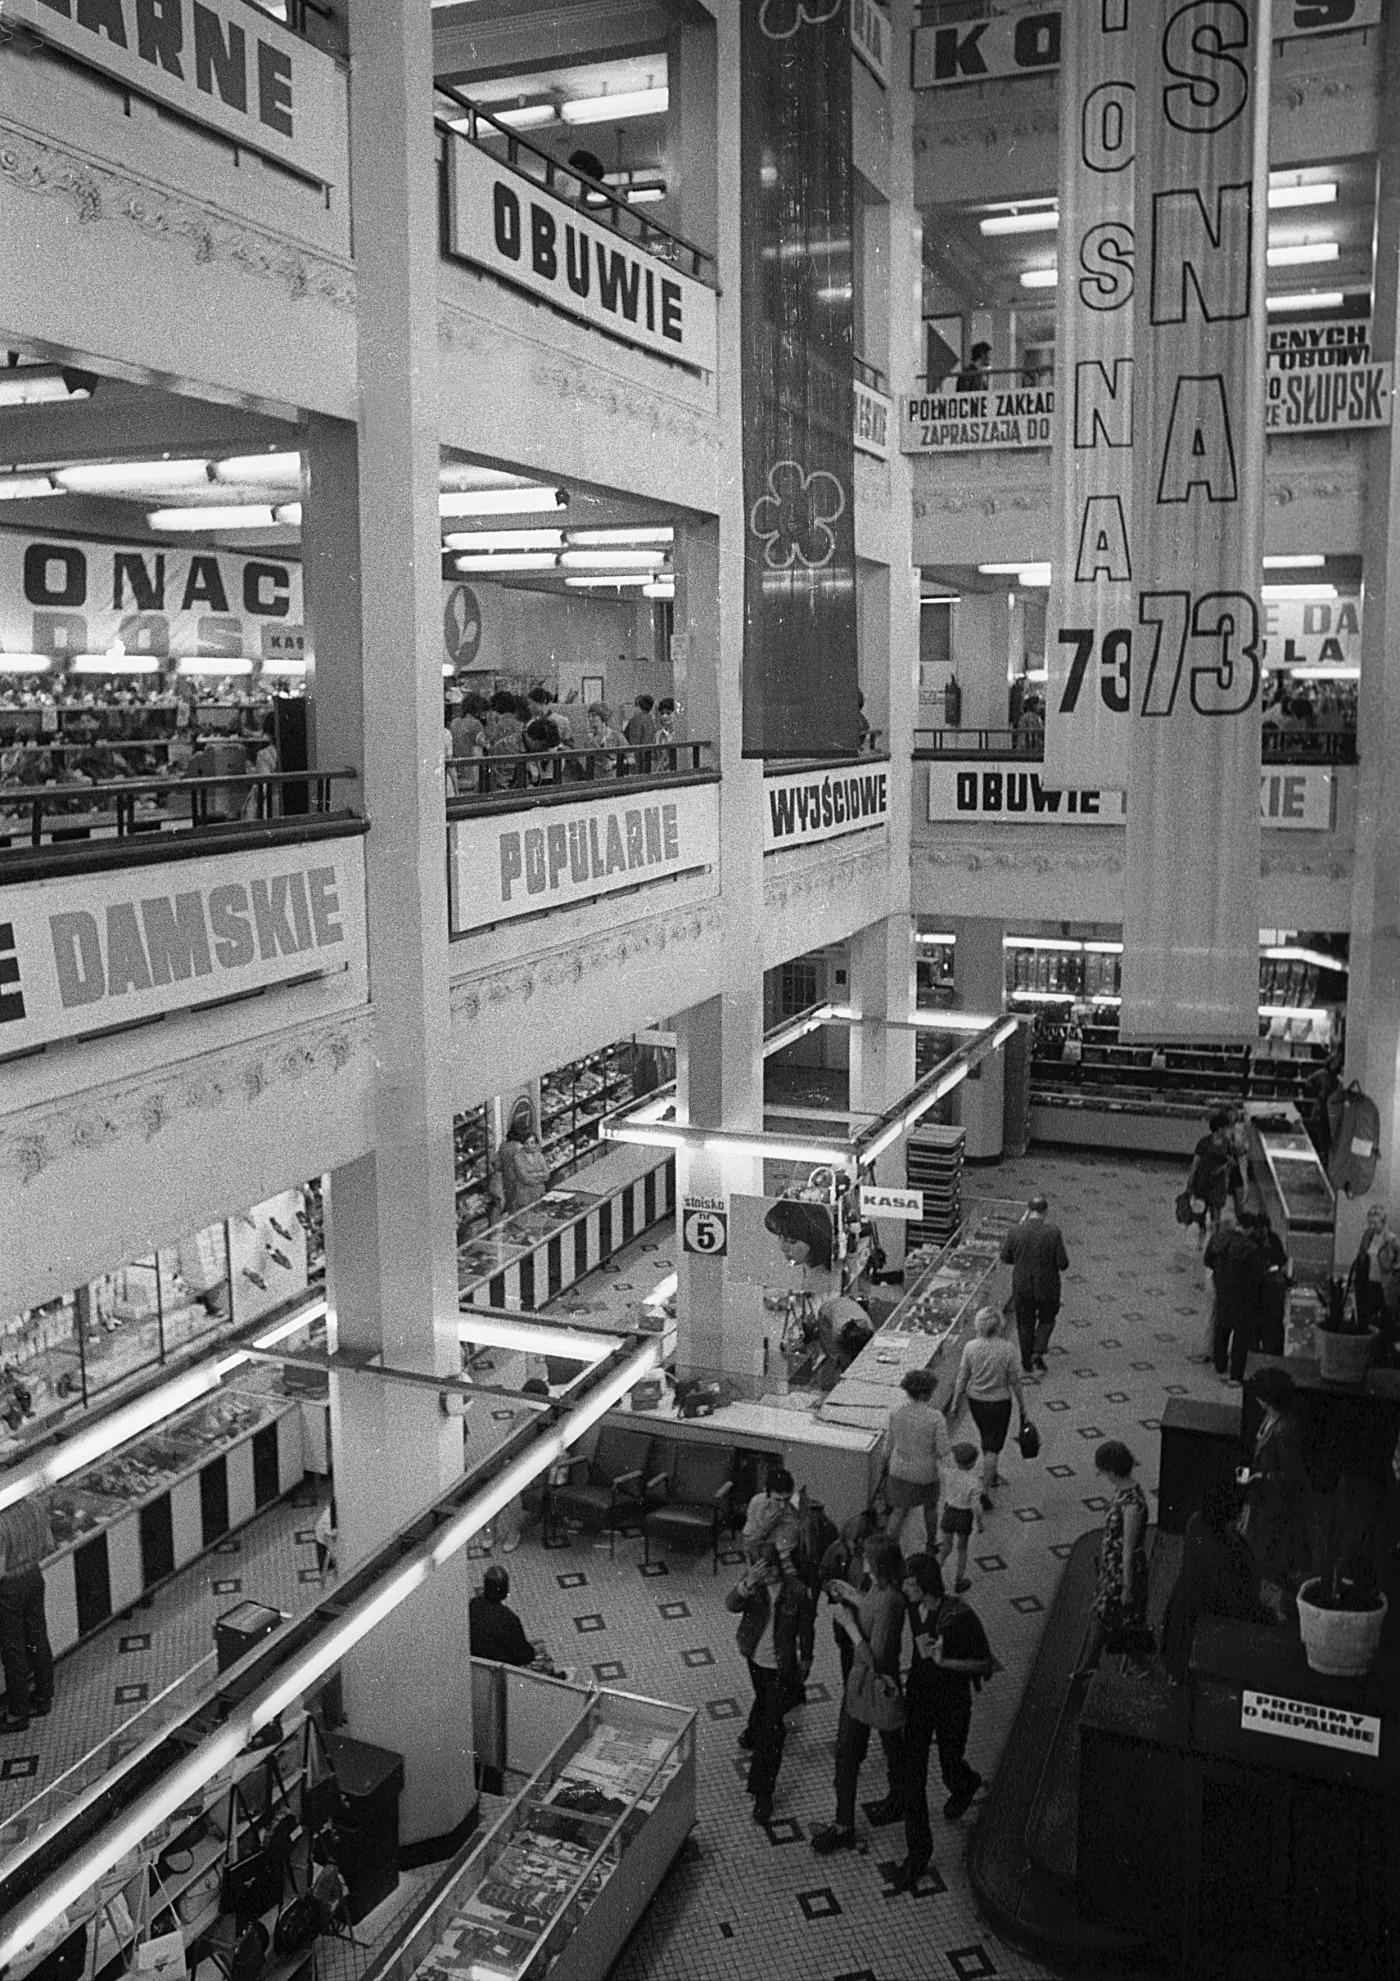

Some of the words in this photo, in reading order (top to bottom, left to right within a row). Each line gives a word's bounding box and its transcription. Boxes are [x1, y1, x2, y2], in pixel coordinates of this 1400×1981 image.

[38, 0, 294, 138] ARNE
[494, 180, 682, 343] OBUWIE
[1027, 418, 1049, 440] DO
[1057, 629, 1132, 713] 73
[1139, 590, 1259, 717] 73
[769, 775, 887, 838] WYJŚCIOWE
[500, 804, 679, 902] POPULARNE
[49, 865, 344, 1009] DAMSKIE
[684, 1196, 724, 1210] stoisko
[863, 1195, 920, 1210] KASA
[697, 1222, 716, 1250] 5
[1243, 1705, 1258, 1717] O
[1261, 1709, 1375, 1744] NIEPALENIE
[1256, 1695, 1364, 1727] PROSIMY
